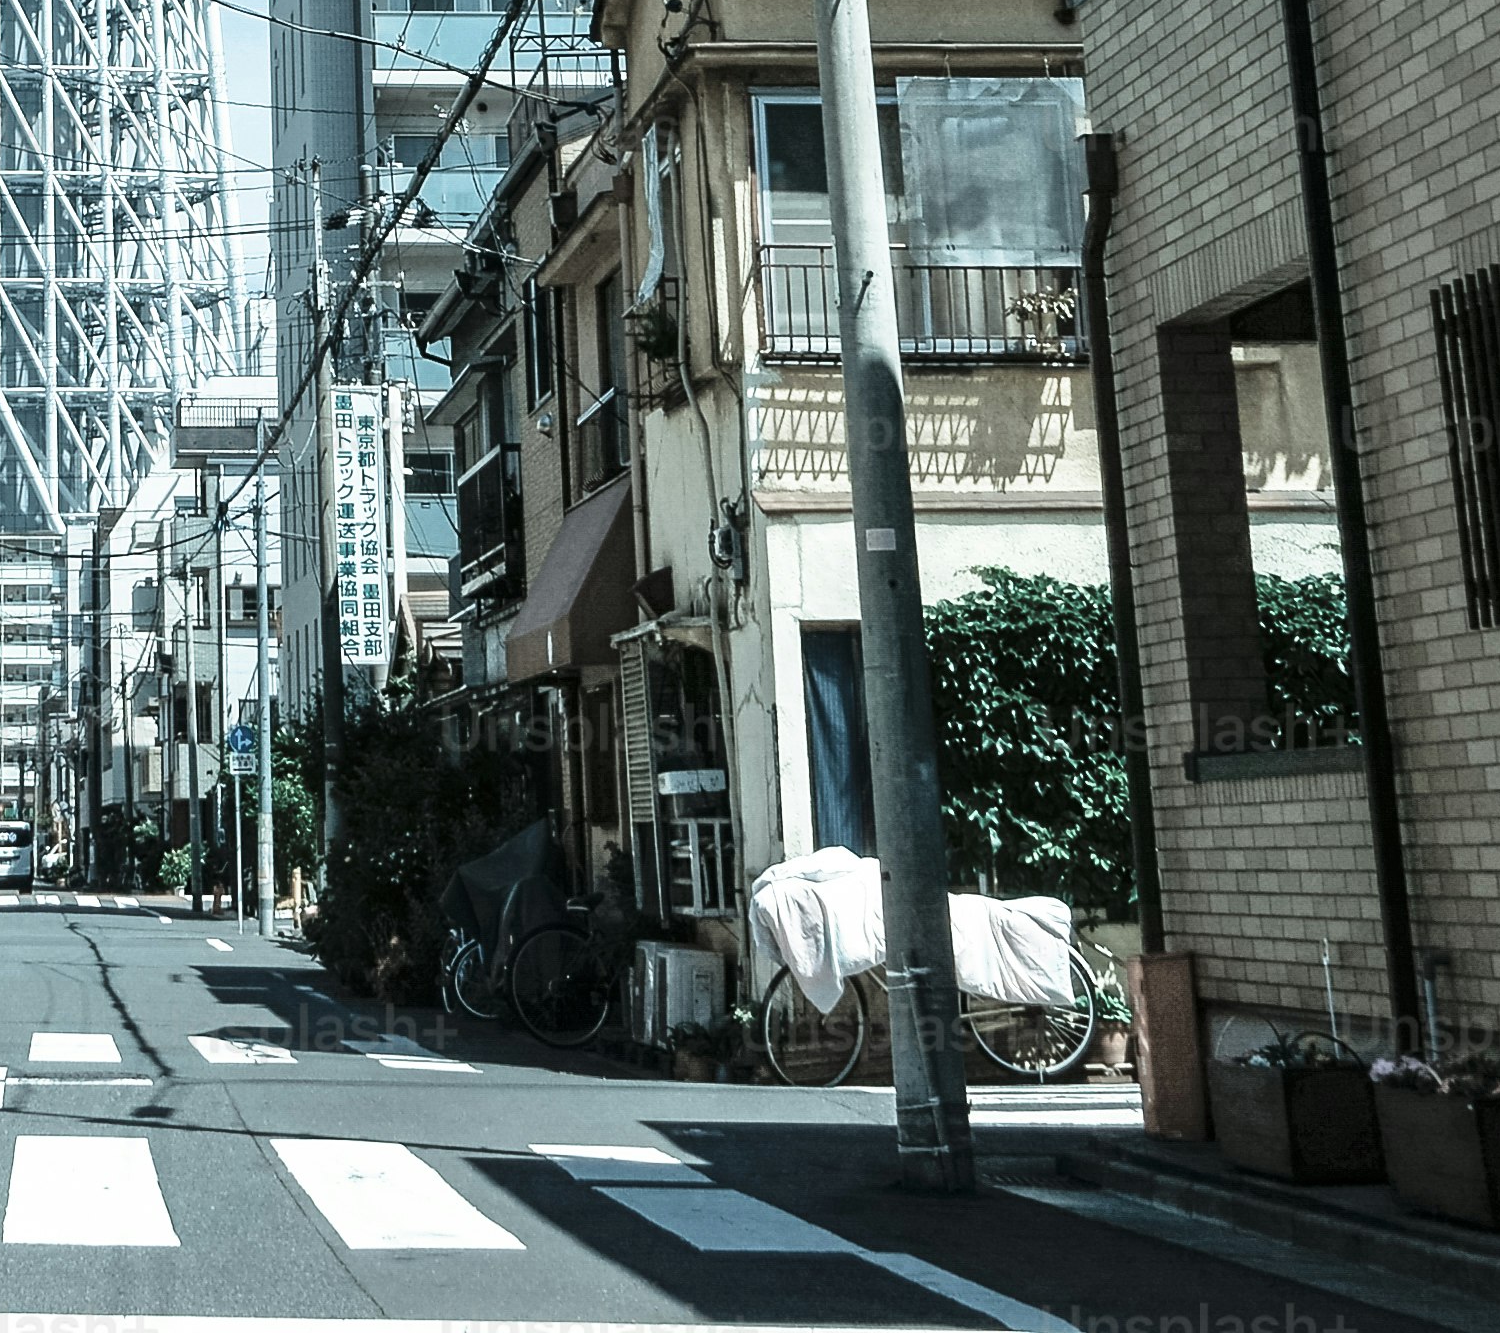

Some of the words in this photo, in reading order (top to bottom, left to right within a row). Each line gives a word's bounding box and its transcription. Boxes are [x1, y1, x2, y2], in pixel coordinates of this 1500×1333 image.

[334, 394, 360, 657] 墨田トラック運送事業協同組合
[357, 415, 379, 575] 東京都トラック協会
[362, 582, 383, 657] 墨田支部
